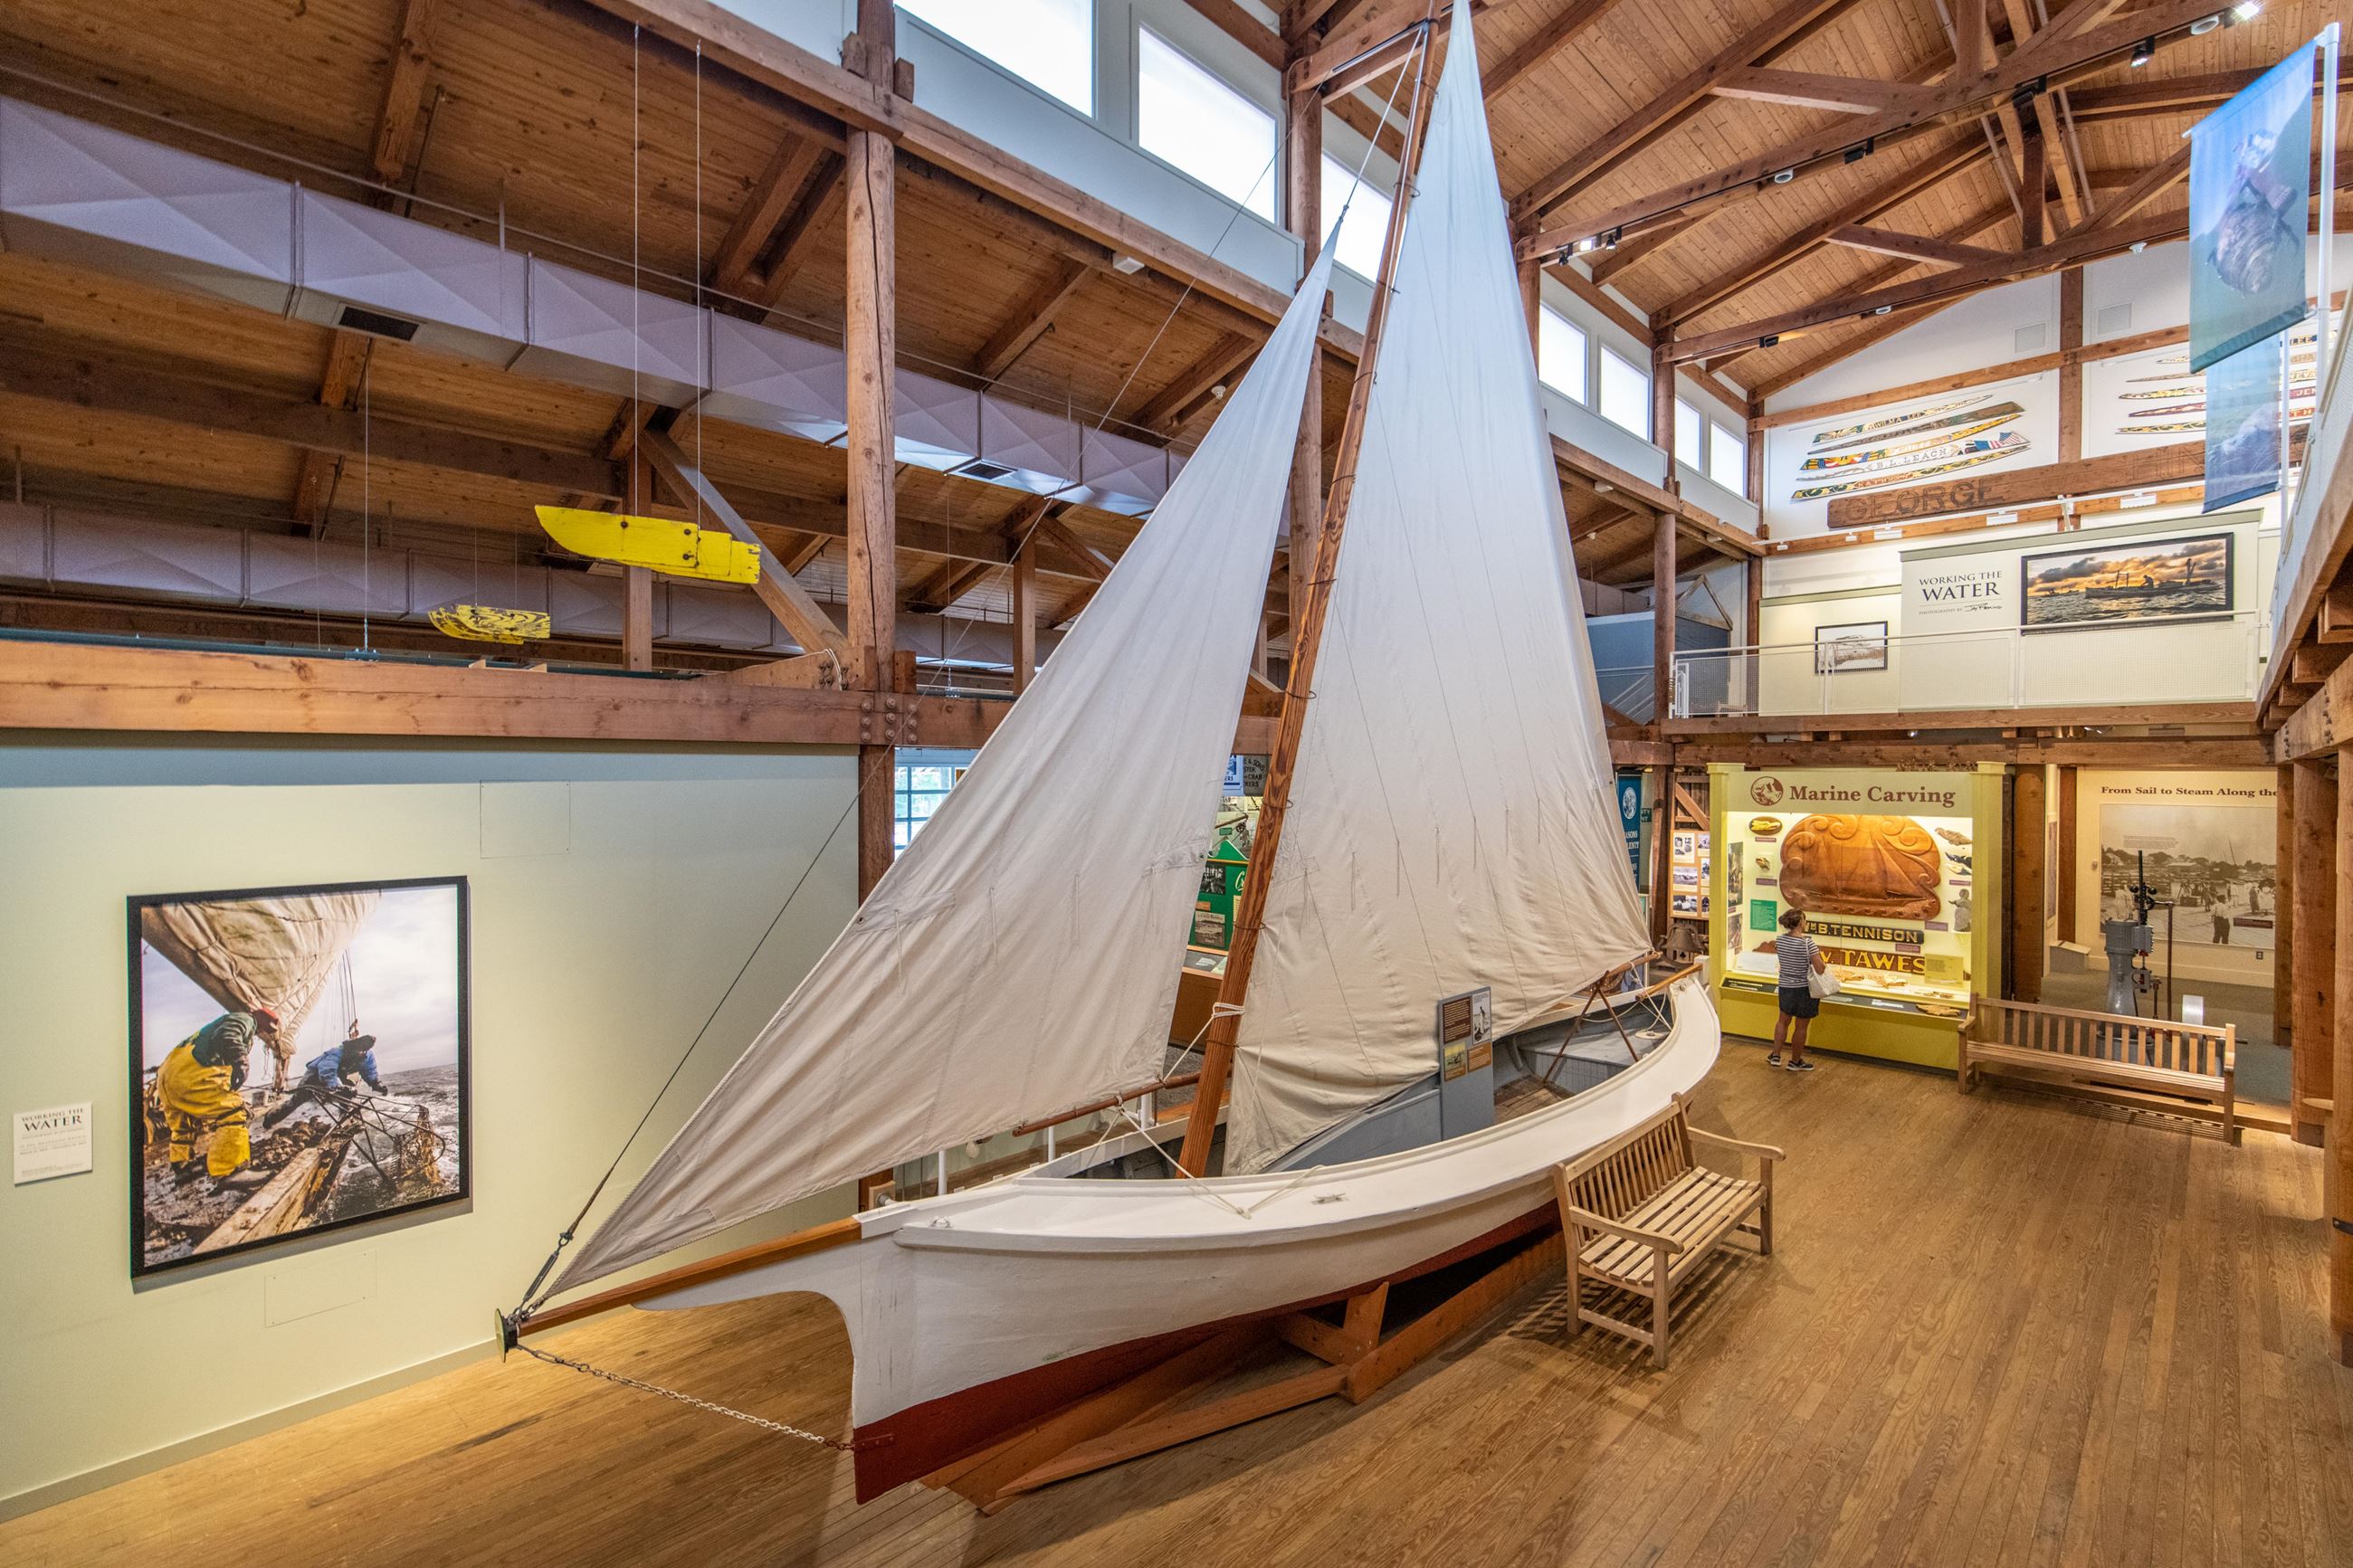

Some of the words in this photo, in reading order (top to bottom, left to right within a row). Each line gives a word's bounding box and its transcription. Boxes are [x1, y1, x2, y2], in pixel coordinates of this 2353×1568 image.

[1903, 448, 1948, 463] LEACH
[1846, 479, 2004, 520] GEORGE
[1919, 573, 1976, 585] WORKING
[1978, 570, 2003, 580] THE
[1921, 582, 2001, 602] WATER
[1789, 784, 1861, 801] Marine
[1867, 785, 1956, 808] Carving
[2101, 786, 2131, 794] From
[2135, 786, 2157, 794] Sail
[2176, 787, 2214, 795] Steam
[2216, 788, 2255, 798] Along
[1831, 925, 1918, 943] TENNISON
[1840, 949, 1925, 974] TAWES
[24, 1115, 82, 1132] WATER
